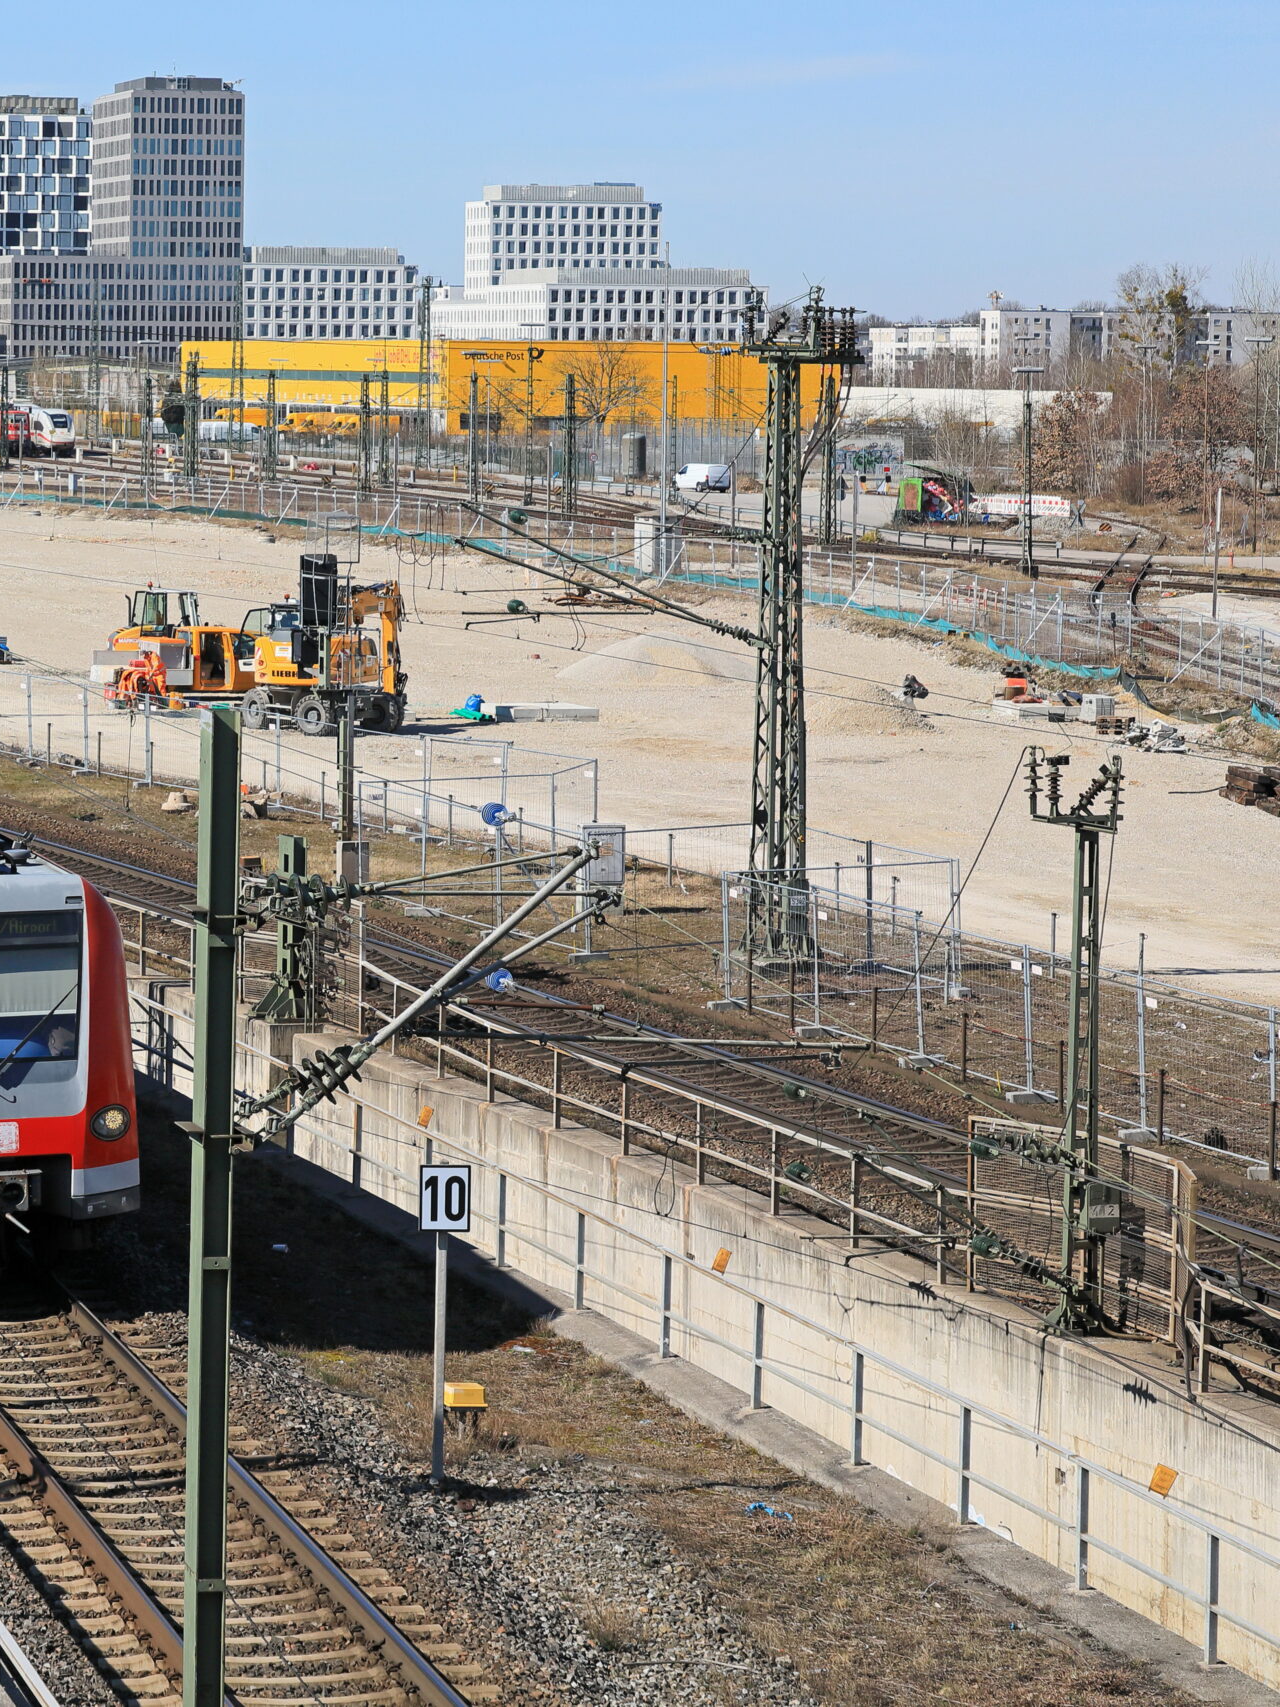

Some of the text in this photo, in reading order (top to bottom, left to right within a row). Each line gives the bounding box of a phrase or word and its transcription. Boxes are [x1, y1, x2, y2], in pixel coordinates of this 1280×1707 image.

[464, 351, 525, 361] Deutsche Post
[425, 1175, 466, 1222] 10
